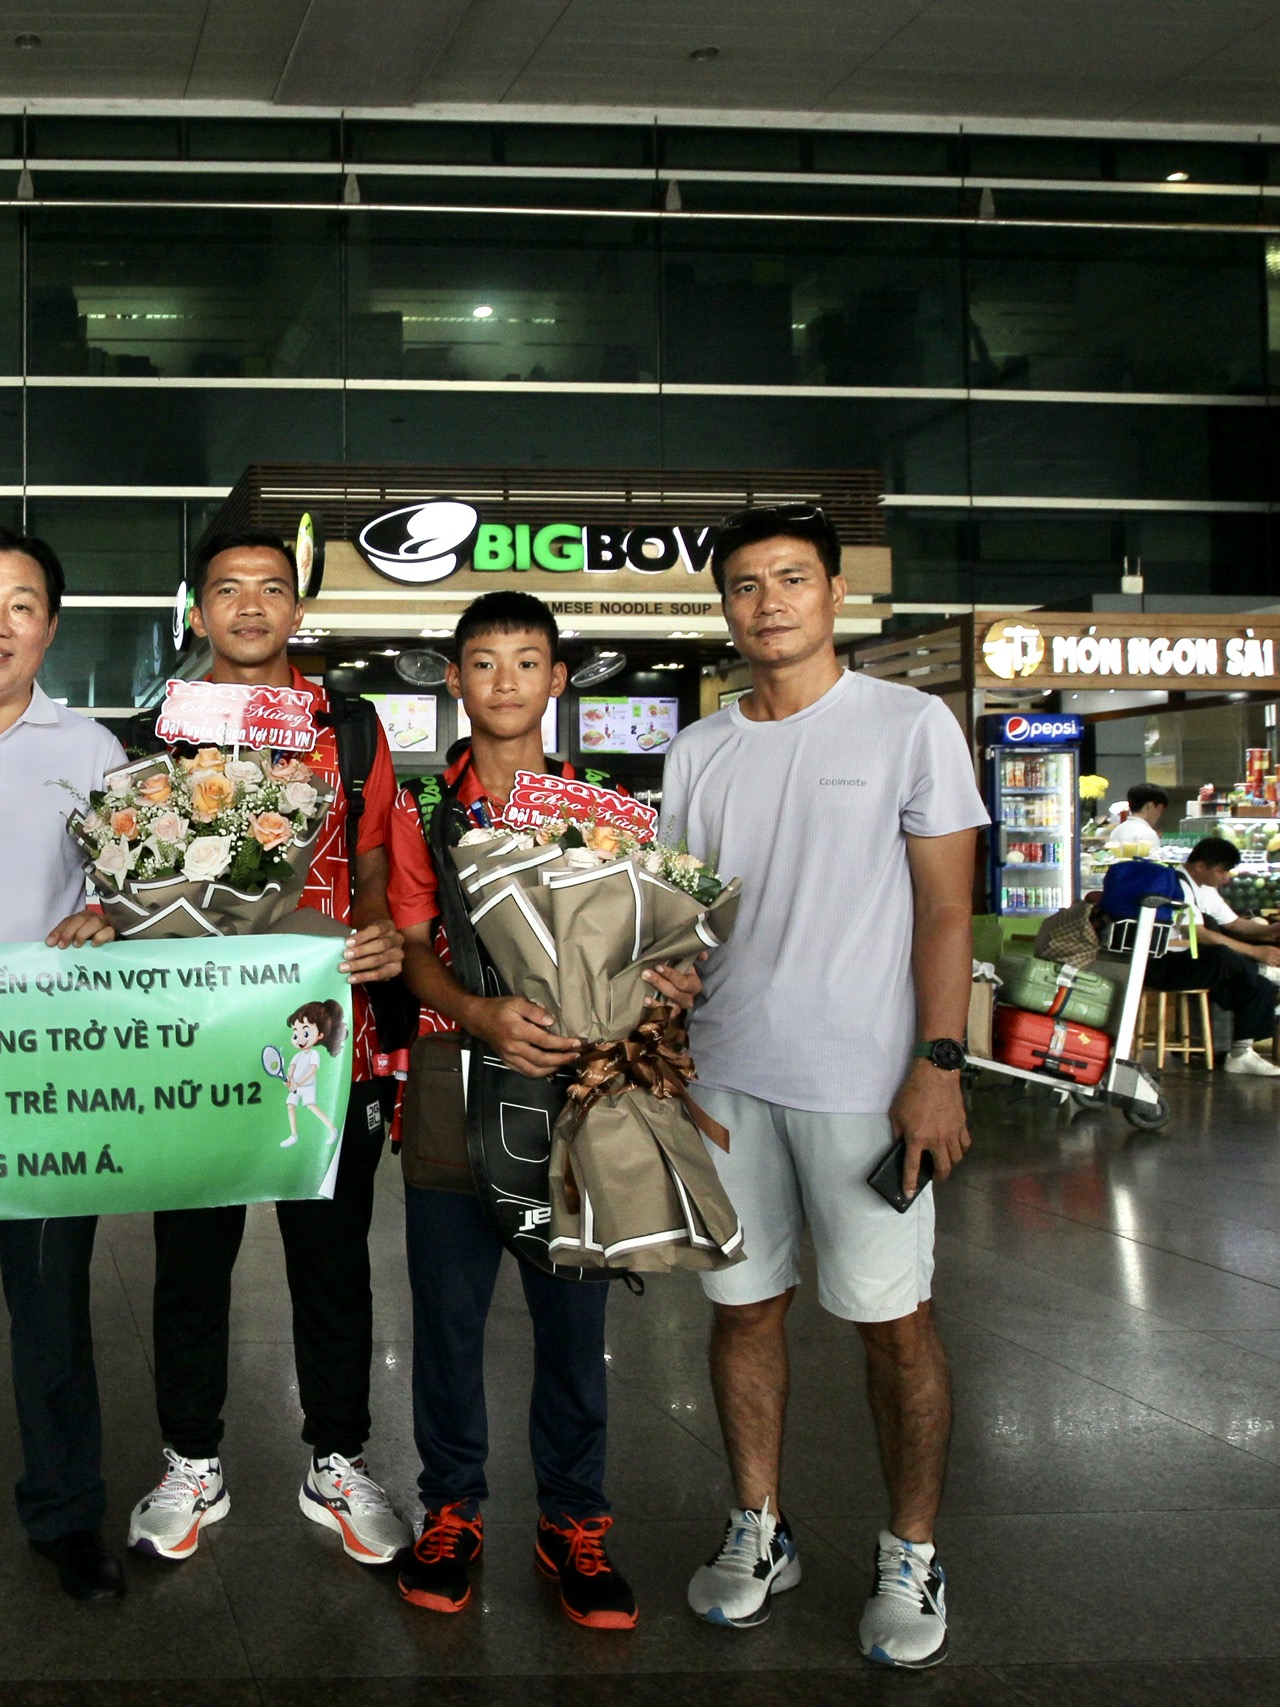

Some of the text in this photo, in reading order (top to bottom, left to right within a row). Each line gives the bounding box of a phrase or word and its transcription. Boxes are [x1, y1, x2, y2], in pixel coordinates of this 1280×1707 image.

[600, 602, 663, 615] NOODLE
[670, 603, 712, 615] SOUP
[1052, 625, 1275, 677] MÓN NGON SÀI
[1030, 720, 1077, 738] pepsi
[819, 778, 867, 787] Coolmate
[35, 964, 112, 998] QUẦN
[118, 967, 170, 994] VỢT
[177, 961, 232, 991] VIỆT
[240, 963, 301, 985] NAM
[46, 1019, 108, 1052] TRỞ
[114, 1018, 150, 1049] VỀ
[157, 1018, 200, 1048] TỪ
[5, 1082, 58, 1115] TRẺ
[67, 1087, 145, 1115] NAM,
[154, 1080, 202, 1109] NỮ
[210, 1081, 262, 1108] U12
[17, 1151, 87, 1177] NAM
[95, 1144, 124, 1175] Á.
